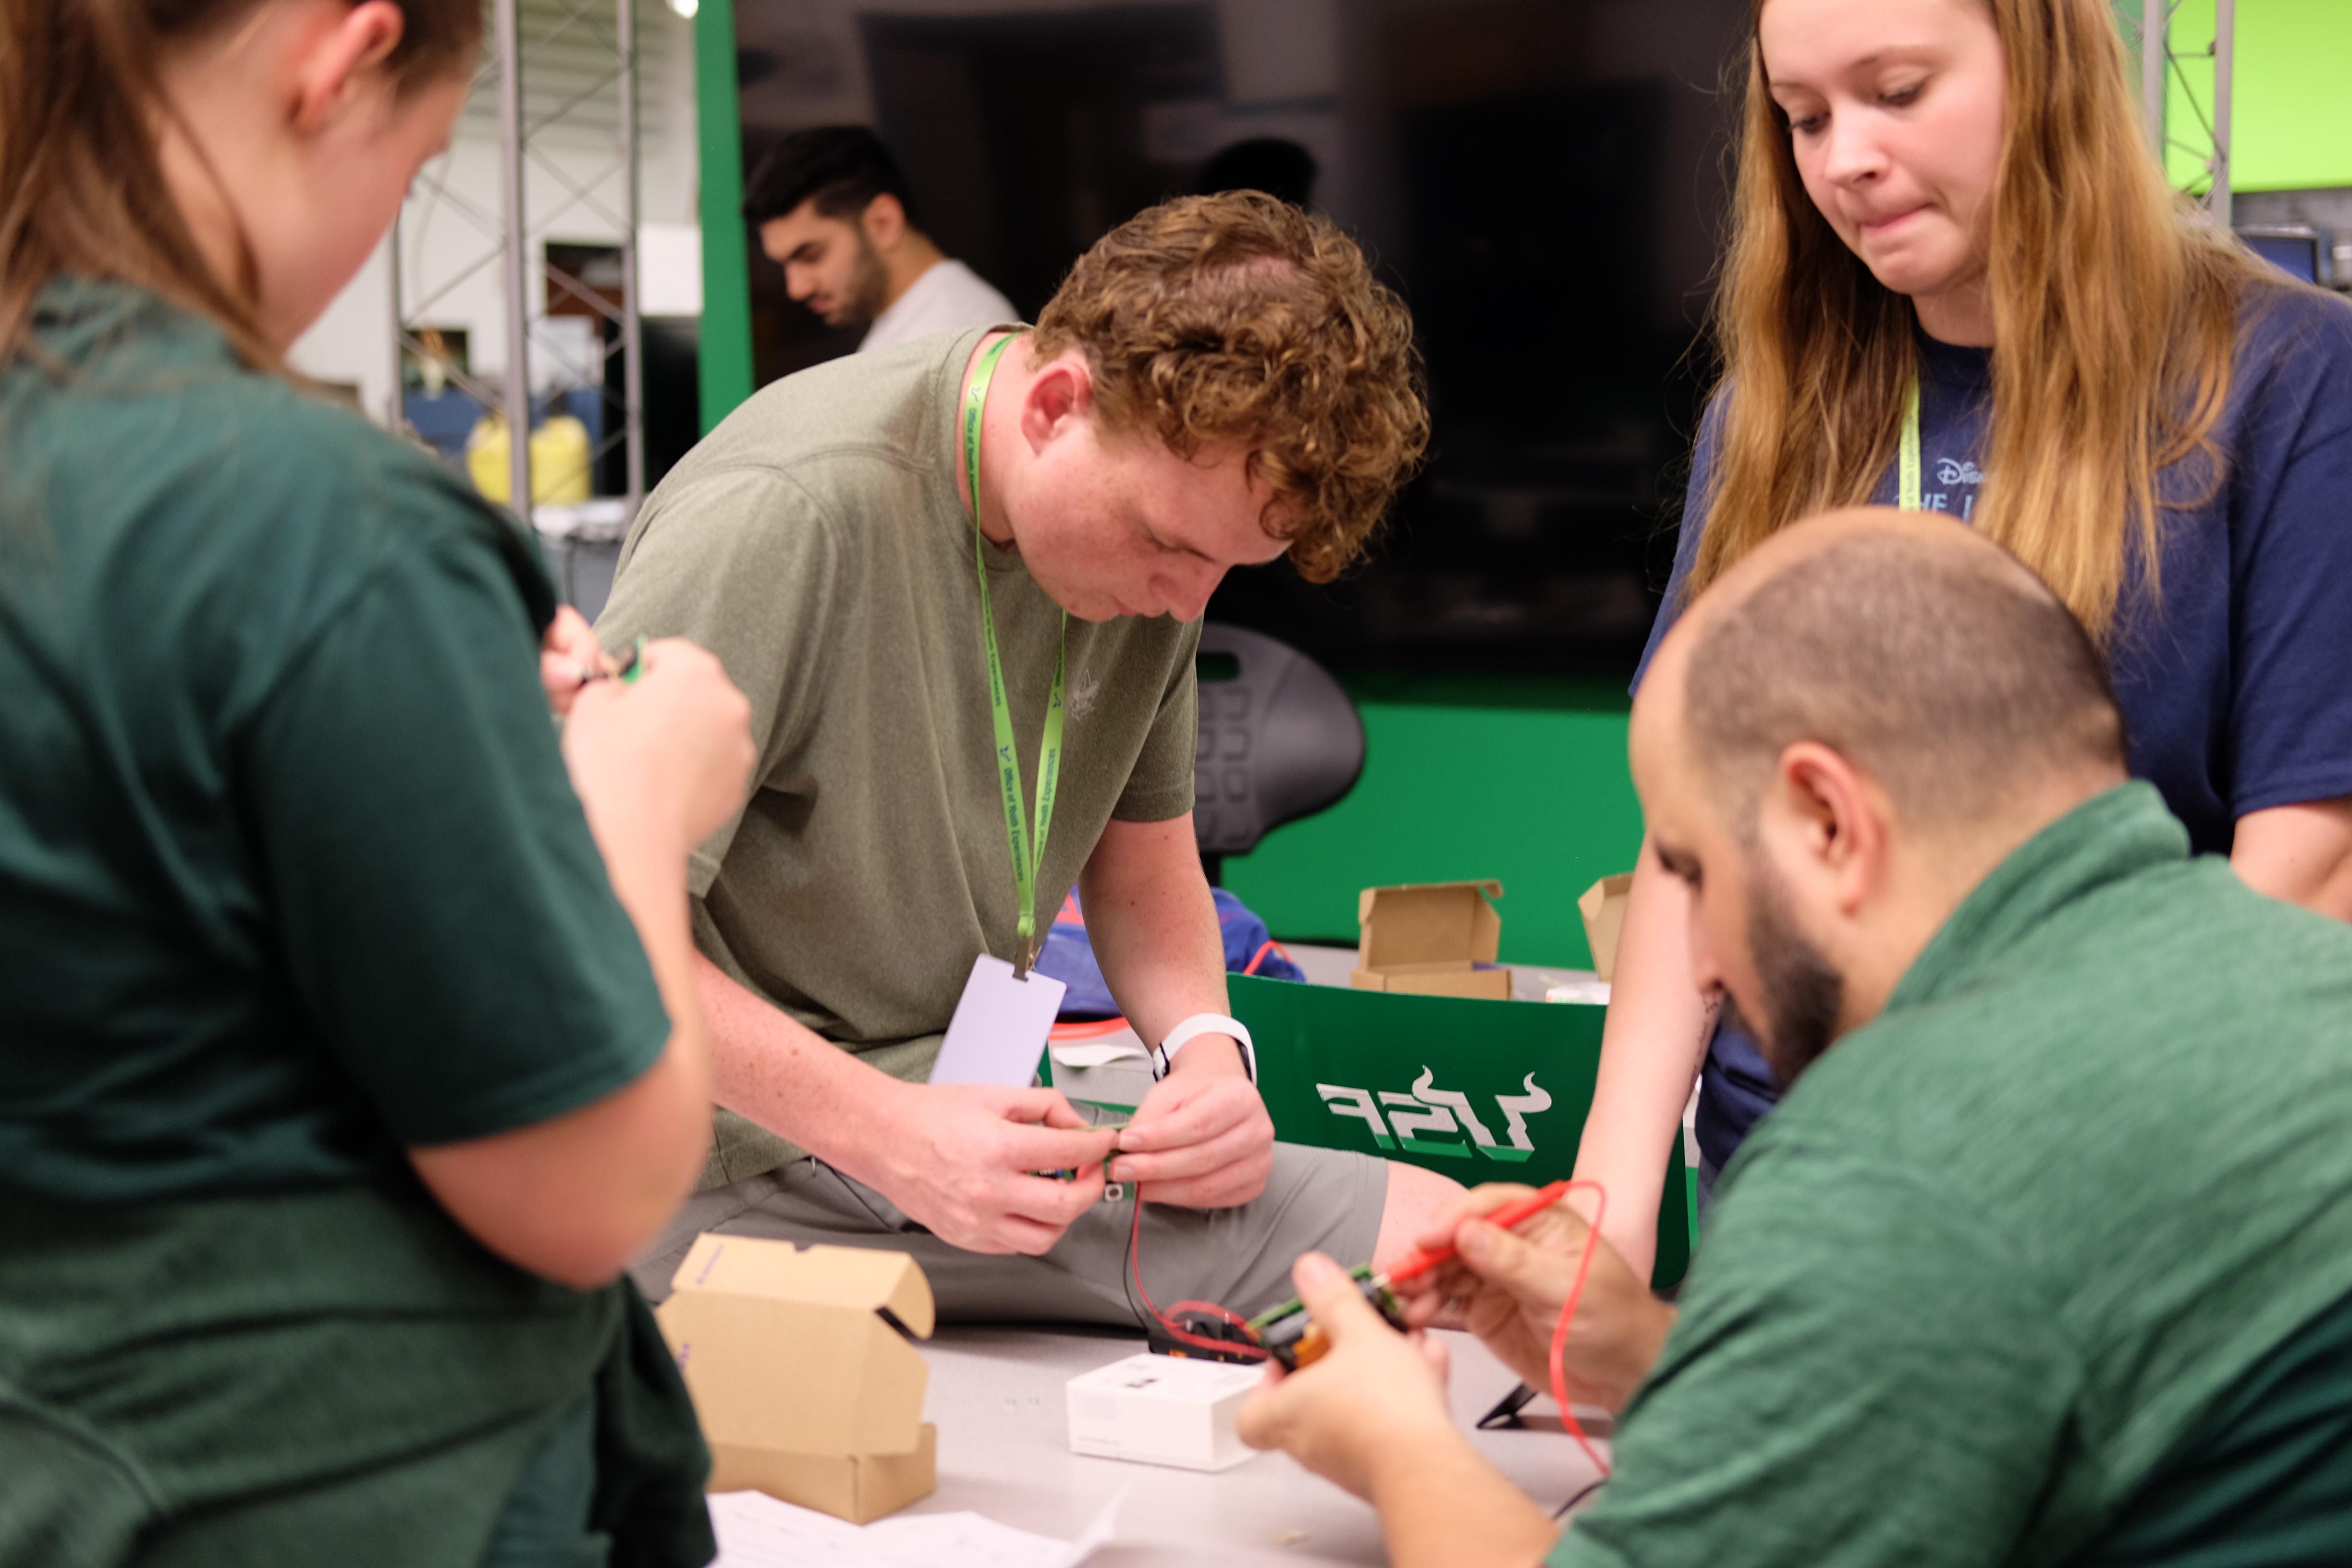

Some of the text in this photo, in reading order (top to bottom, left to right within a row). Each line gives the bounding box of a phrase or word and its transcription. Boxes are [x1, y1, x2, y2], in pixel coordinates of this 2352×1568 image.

[1041, 747, 1056, 801] Experiences
[1004, 767, 1024, 882] Office of Youth Experiences
[1040, 804, 1049, 827] Youth
